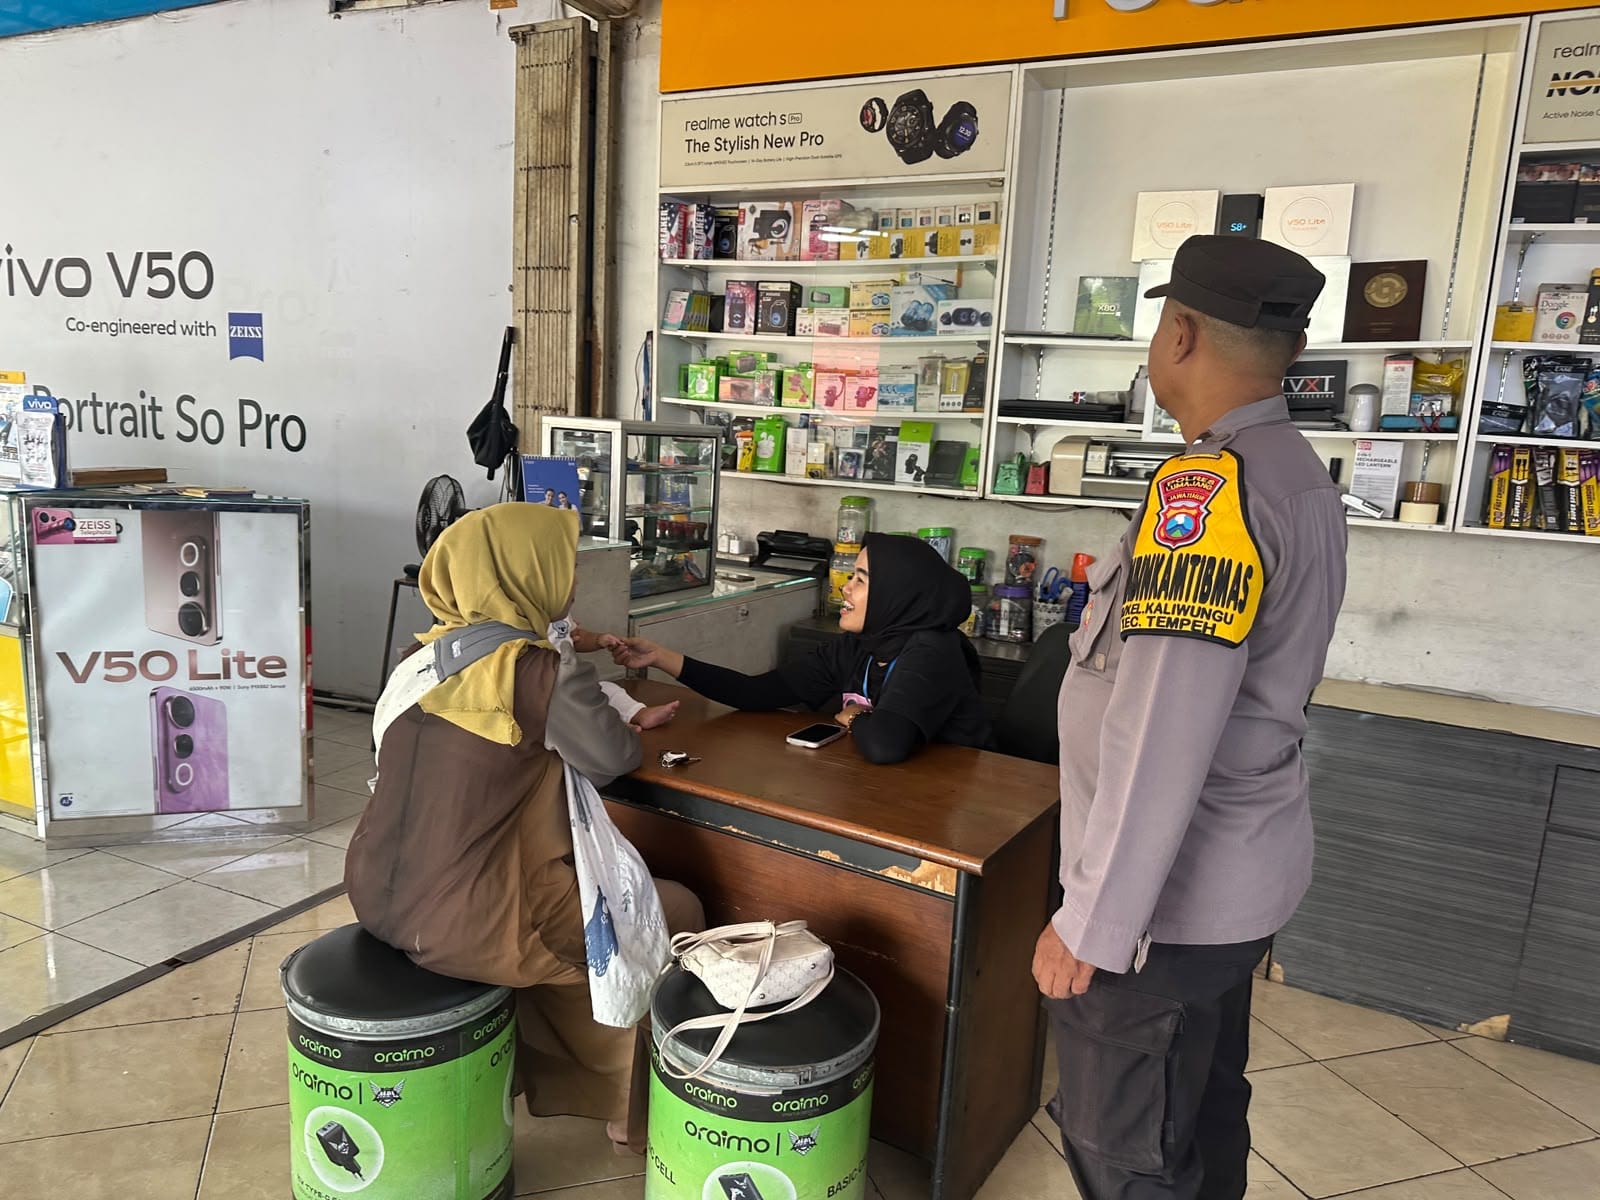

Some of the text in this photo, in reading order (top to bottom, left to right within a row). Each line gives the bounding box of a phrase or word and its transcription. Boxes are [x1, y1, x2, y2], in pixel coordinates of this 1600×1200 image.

[685, 115, 730, 132] realme
[734, 112, 777, 129] watch
[1542, 111, 1569, 119] Active
[1570, 110, 1595, 118] Noise
[684, 131, 825, 155] The Stylish New Pro
[694, 211, 705, 252] SPEAKER
[0, 244, 93, 298] ivo
[106, 250, 214, 300] V50
[65, 317, 217, 338] Co-engineered with
[229, 325, 263, 339] ZEISS
[28, 398, 52, 410] vivo
[176, 394, 225, 446] So
[238, 399, 307, 453] Pro
[1165, 482, 1213, 491] LUMAJANG
[1167, 476, 1215, 486] POLRES
[1168, 493, 1187, 502] JAWA
[80, 521, 111, 530] ZEISS
[1148, 616, 1217, 636] TEMPEH
[56, 648, 288, 684] V50 Lite
[299, 1034, 342, 1059] oraimo
[374, 1046, 435, 1063] oraimo
[292, 1061, 353, 1100] oraimo
[684, 1082, 738, 1109] oraimo
[772, 1094, 829, 1112] oraimo
[684, 1120, 770, 1153] oraimo
[655, 1156, 676, 1185] CELL
[827, 1168, 858, 1198] BASIC
